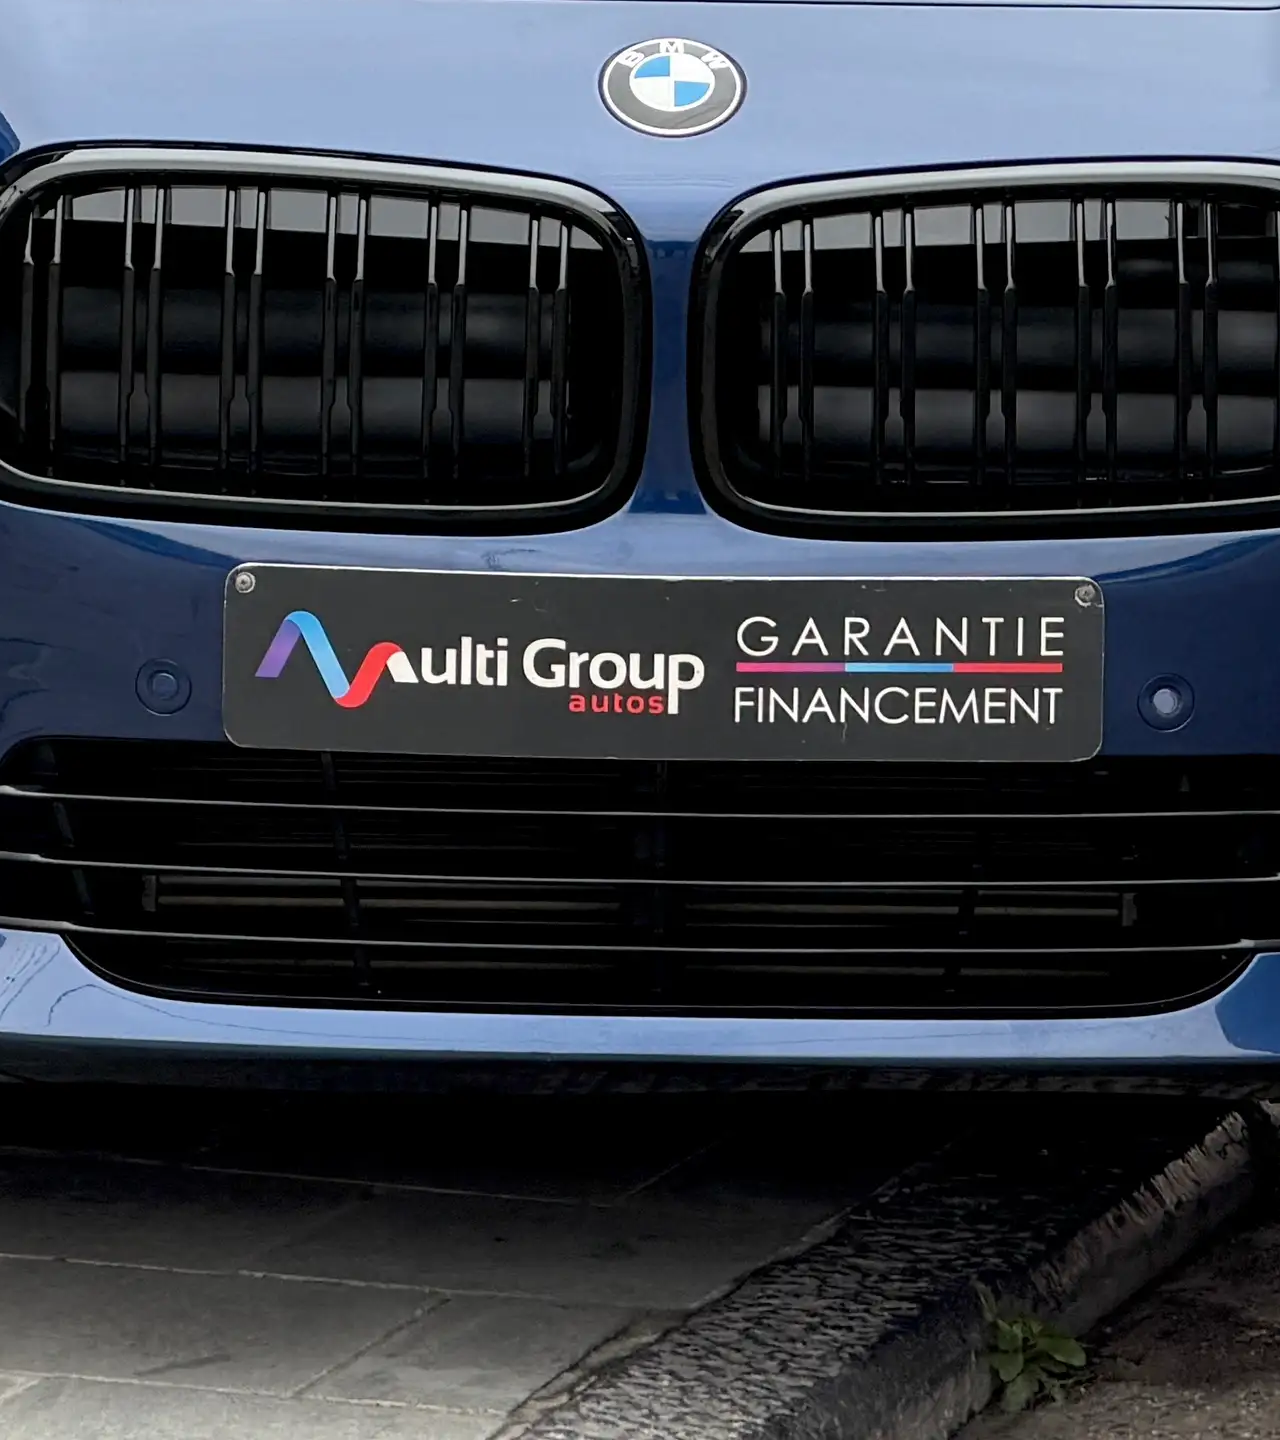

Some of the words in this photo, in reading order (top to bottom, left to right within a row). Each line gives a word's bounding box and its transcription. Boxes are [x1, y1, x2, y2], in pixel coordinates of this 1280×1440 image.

[616, 41, 731, 69] BMW
[736, 616, 1065, 657] GARANTIE
[522, 638, 706, 715] Group
[568, 693, 665, 714] autos
[733, 686, 1064, 724] FINANCEMENT
